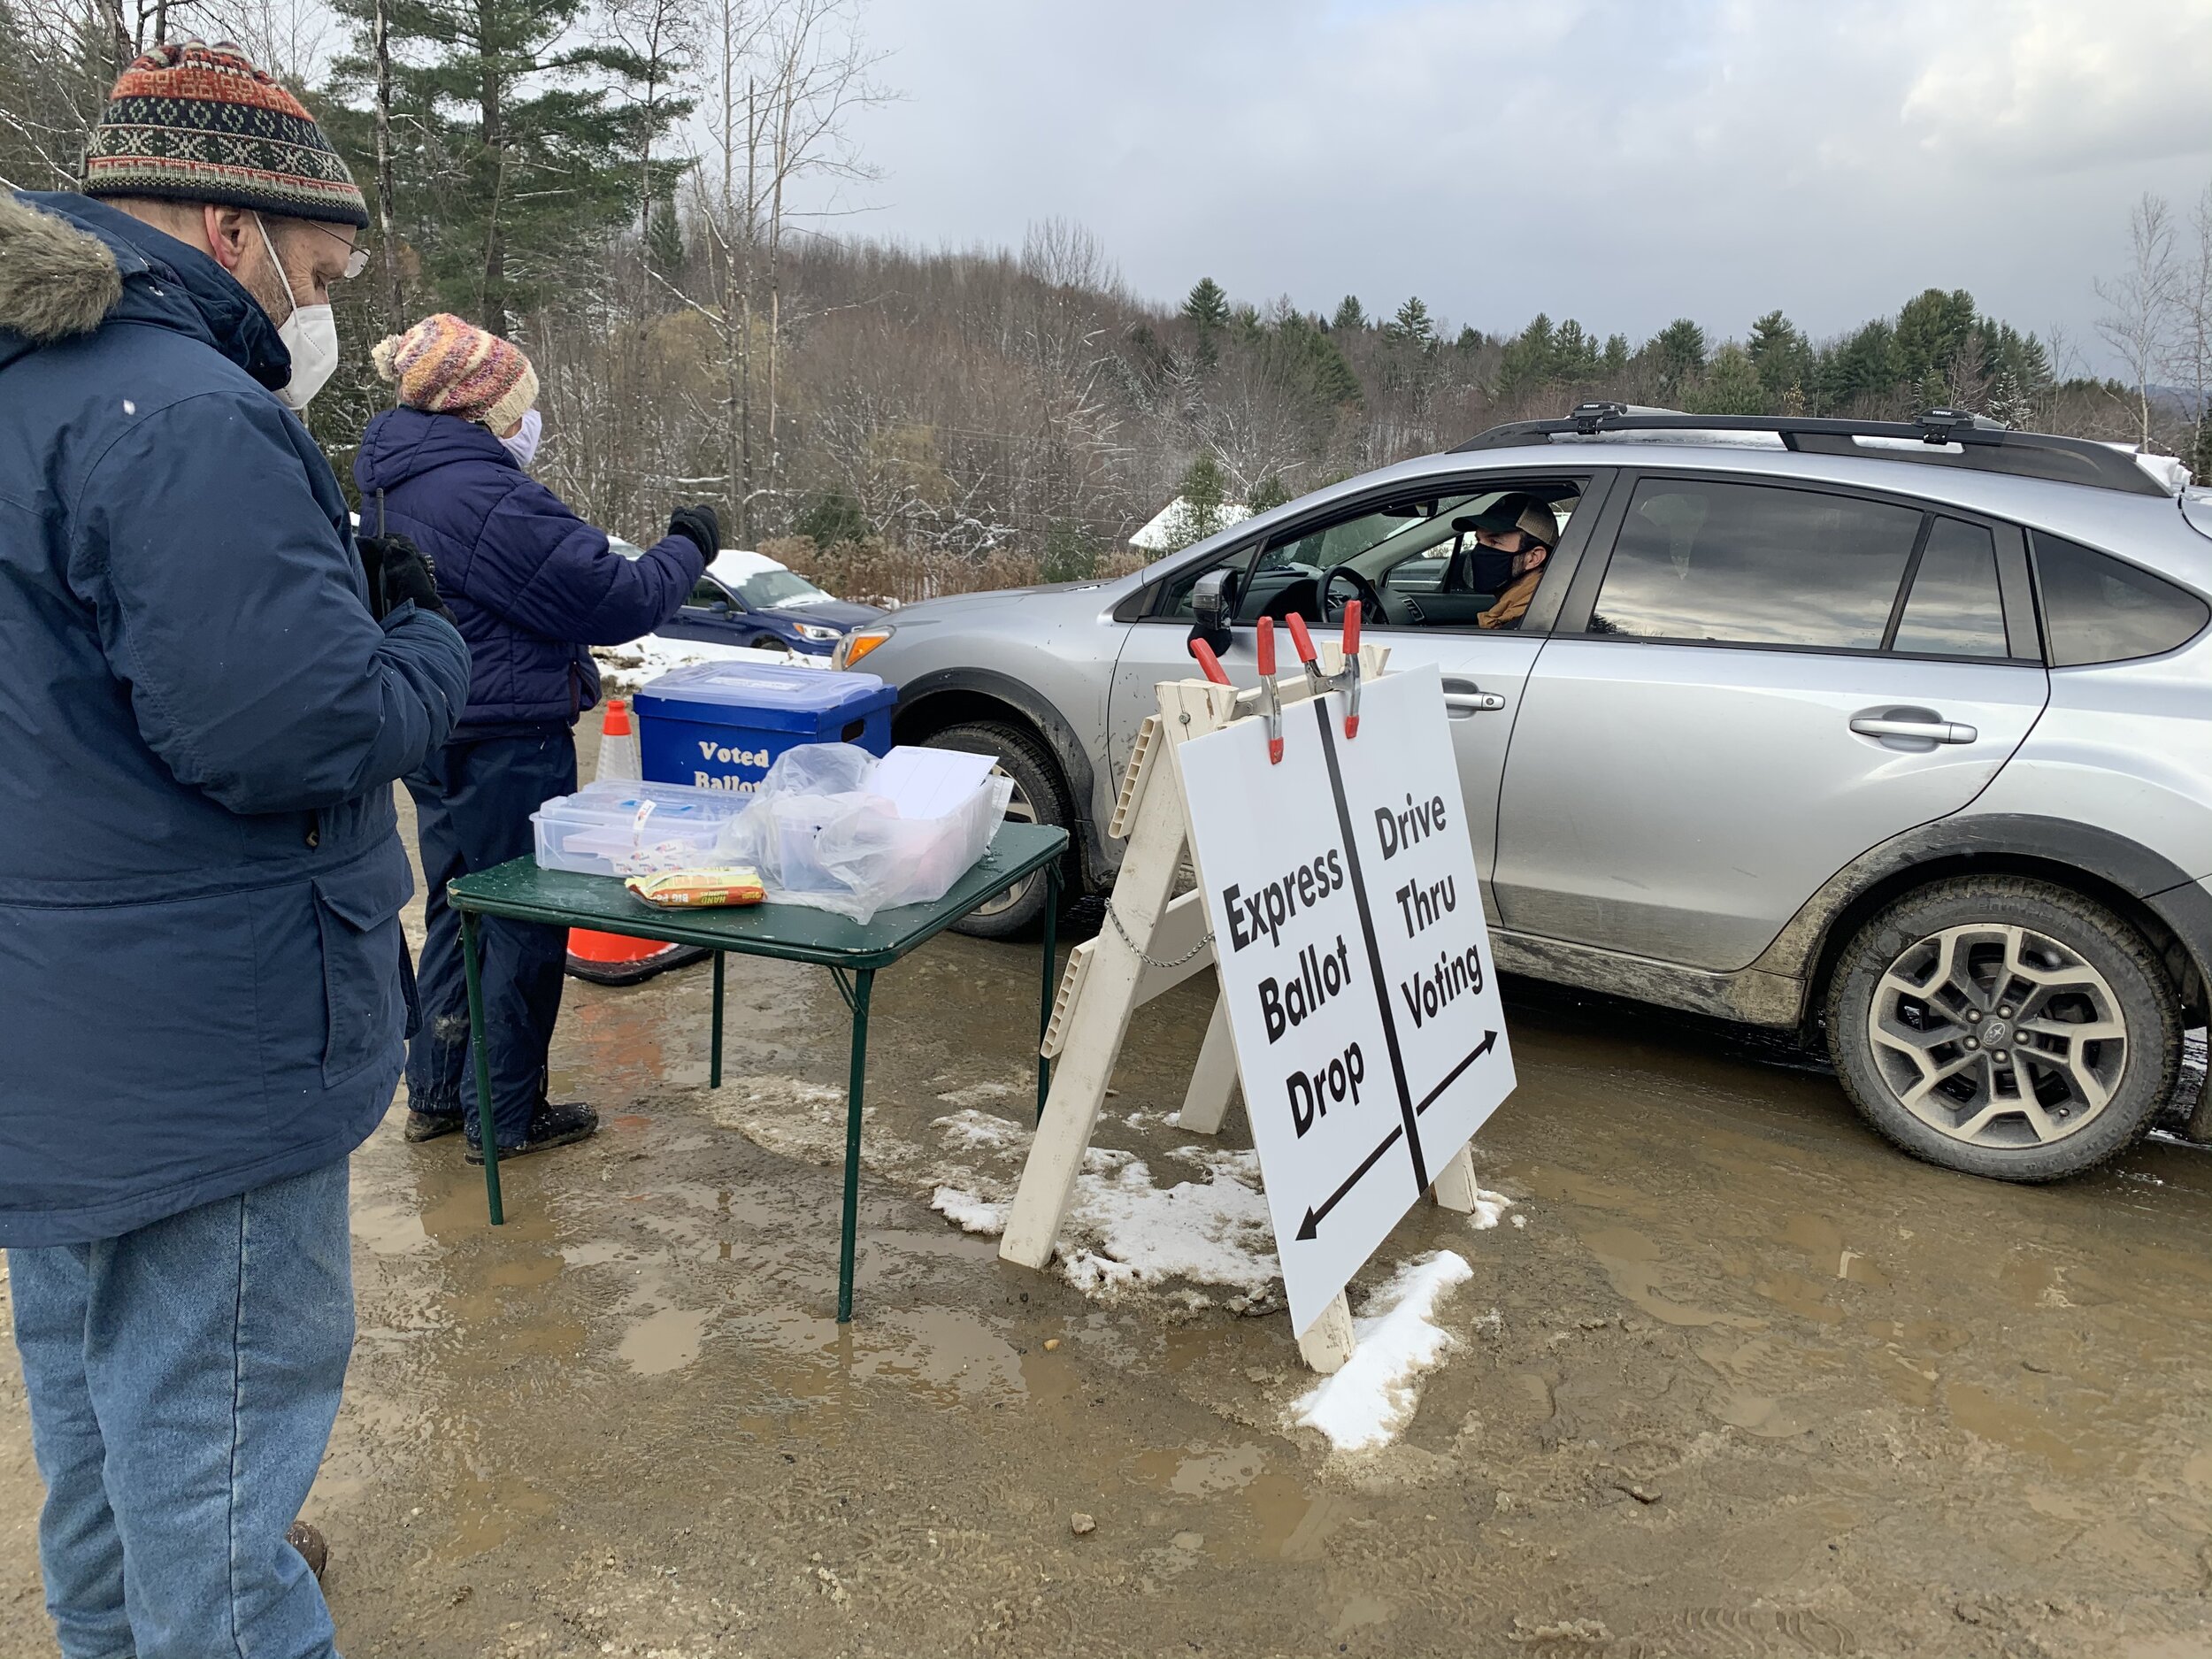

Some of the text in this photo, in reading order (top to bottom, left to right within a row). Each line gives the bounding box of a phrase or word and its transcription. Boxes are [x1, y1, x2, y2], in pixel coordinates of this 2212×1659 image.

[698, 741, 769, 768] Voted
[1375, 793, 1448, 861] Drive
[672, 893, 688, 902] BIG
[1223, 847, 1344, 953] Express
[1396, 874, 1455, 939] Thru
[1258, 934, 1352, 1045] Ballot
[1402, 943, 1484, 1029] Voting
[1286, 1041, 1364, 1140] Drop
